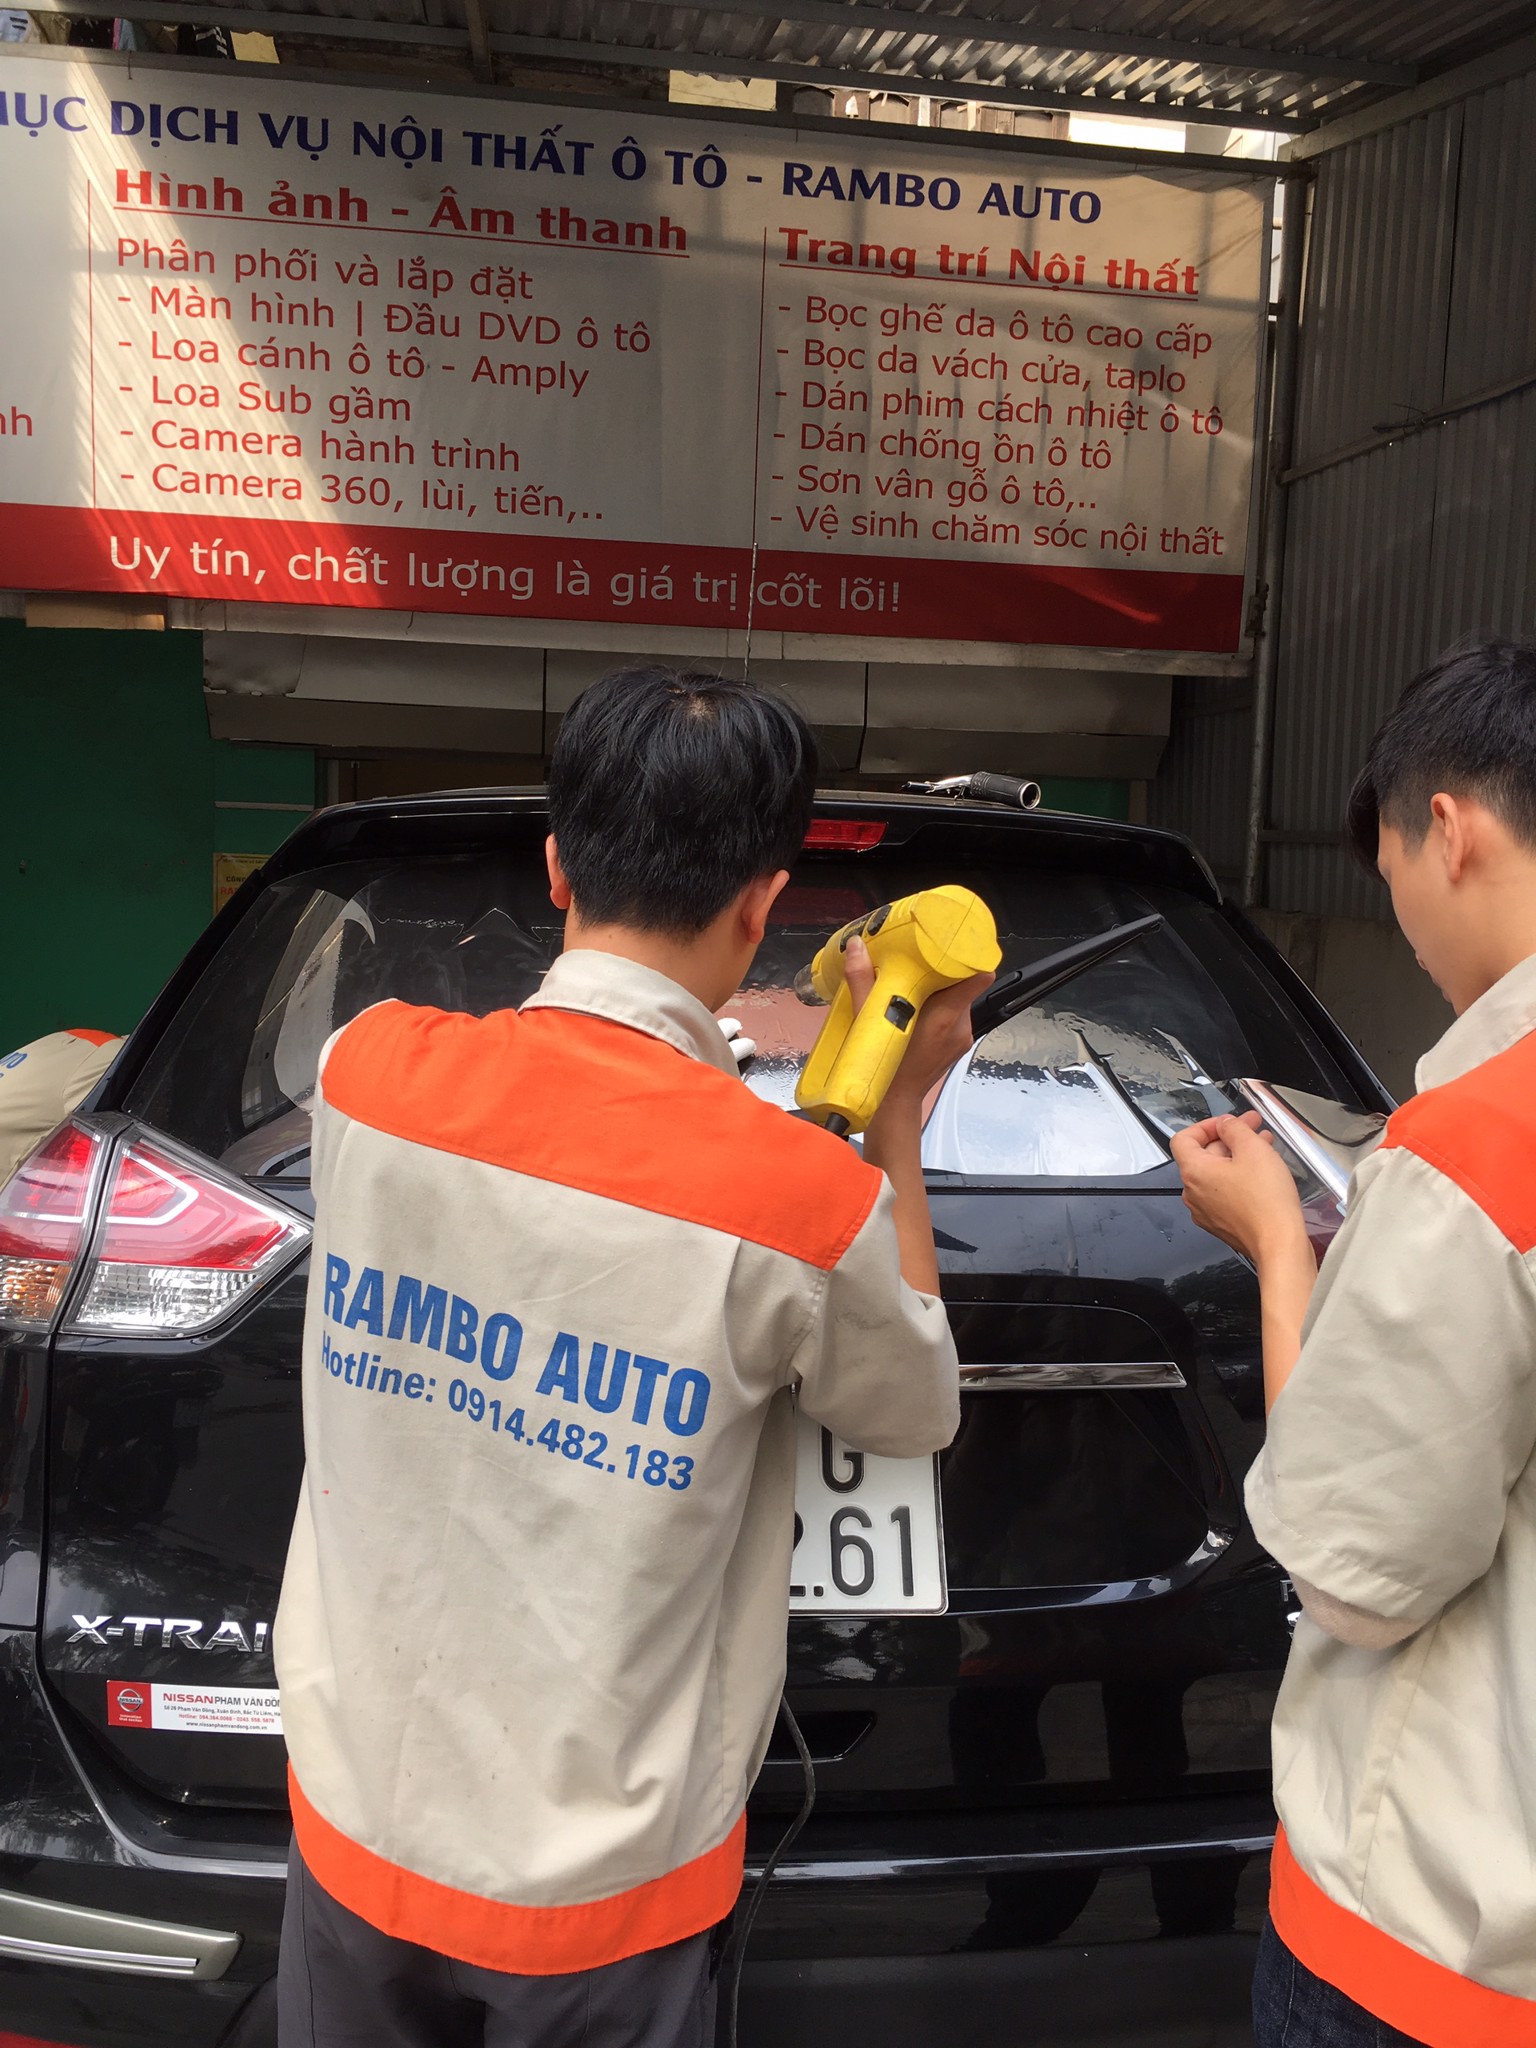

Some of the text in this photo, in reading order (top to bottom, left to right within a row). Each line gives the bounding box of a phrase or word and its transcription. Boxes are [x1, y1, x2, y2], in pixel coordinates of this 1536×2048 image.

[111, 100, 238, 147] DỊCH
[258, 112, 329, 161] VỤ
[353, 115, 442, 169] NỘI
[462, 124, 594, 176] THẤT
[612, 136, 647, 181] Ô
[665, 144, 727, 188] TÔ
[783, 162, 961, 211] RAMBO
[977, 182, 1101, 223] AUTO
[116, 169, 243, 212] Hình
[268, 180, 368, 222] ảnh
[429, 186, 514, 235] Âm
[536, 206, 687, 250] thanh
[118, 238, 533, 304] Phân phối và lắp đặt
[779, 227, 1199, 294] Trang trí Nội thất
[151, 286, 232, 320] Màn
[251, 292, 335, 328] hình
[384, 302, 460, 338] Đầu
[479, 311, 560, 345] DVD
[576, 317, 599, 348] ô
[614, 321, 650, 352] tô
[805, 296, 867, 331] Bọc
[880, 302, 946, 336] ghế
[955, 308, 996, 338] da
[1008, 310, 1029, 340] ô
[1042, 314, 1075, 344] tô
[1086, 323, 1144, 350] cao
[1155, 322, 1212, 359] cấp
[152, 331, 219, 363] Loa
[237, 337, 330, 371] cánh
[349, 342, 370, 374] ô
[387, 346, 425, 378] tô
[471, 355, 589, 397] Amply
[803, 340, 865, 374] Bọc
[877, 345, 918, 375] da
[931, 349, 1008, 381] vách
[1021, 354, 1092, 392] cửa,
[1105, 361, 1186, 396] taplo
[152, 375, 220, 408] Loa
[238, 382, 312, 415] Sub
[329, 387, 411, 424] gầm
[802, 380, 868, 412] Dán
[882, 388, 964, 421] phim
[977, 393, 1052, 425] cách
[1066, 399, 1148, 436] nhiệt
[1159, 405, 1180, 433] ô
[1192, 406, 1224, 435] tô
[152, 420, 302, 457] Camera
[321, 430, 414, 464] hành
[432, 438, 520, 471] trình
[800, 422, 866, 454] Dán
[879, 429, 980, 467] chống
[994, 432, 1034, 464] ồn
[1047, 437, 1068, 466] ô
[1080, 439, 1112, 469] tô
[152, 463, 303, 500] Camera
[320, 474, 403, 513] 360,
[422, 479, 477, 517] lùi,
[494, 485, 603, 524] tiến,..
[797, 465, 861, 495] Sơn
[875, 470, 933, 498] vân
[947, 468, 988, 508] gỗ
[1000, 475, 1020, 505] ô
[1033, 478, 1096, 513] tô,..
[796, 505, 839, 540] Vệ
[851, 510, 918, 539] sinh
[931, 514, 1020, 545] chăm
[1034, 521, 1087, 548] sóc
[1100, 526, 1147, 557] nội
[1160, 527, 1224, 556] thất
[110, 536, 899, 612] Uy tín, chất lượng là giá trị cốt lõi!
[323, 1252, 711, 1437] RAMBO AUTO
[321, 1330, 695, 1490] Hotline: 0914.482.183
[790, 1505, 914, 1597] .61
[65, 1614, 268, 1653] X-TRAI
[163, 1693, 213, 1704] NISSAN
